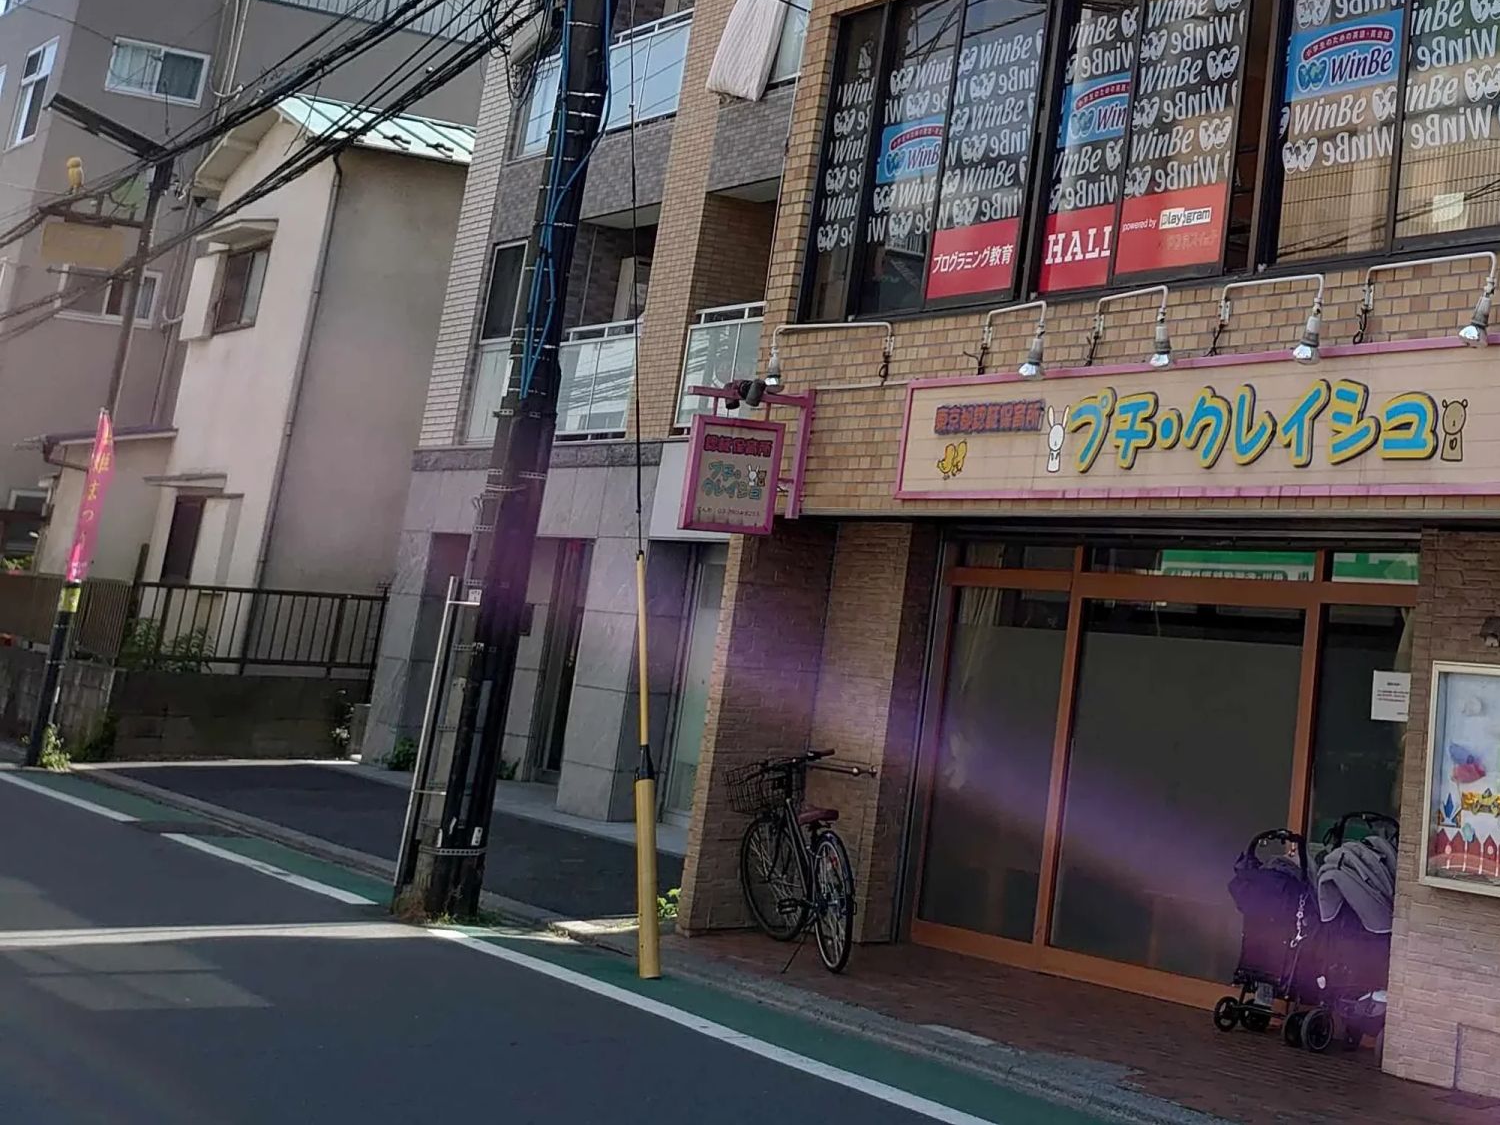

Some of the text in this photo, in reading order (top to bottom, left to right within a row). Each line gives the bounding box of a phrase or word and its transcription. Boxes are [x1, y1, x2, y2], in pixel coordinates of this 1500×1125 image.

[979, 34, 1032, 70] WinBe
[1330, 46, 1393, 85] WinBe
[1139, 56, 1203, 95] WinBe
[971, 97, 1024, 132] WinBe
[1294, 94, 1367, 136] WinBe
[1131, 125, 1195, 164] WinBe
[962, 159, 1016, 194] WinBe
[932, 242, 1014, 275] プログラミング教育
[1068, 378, 1439, 474] プチ・クレイシュ
